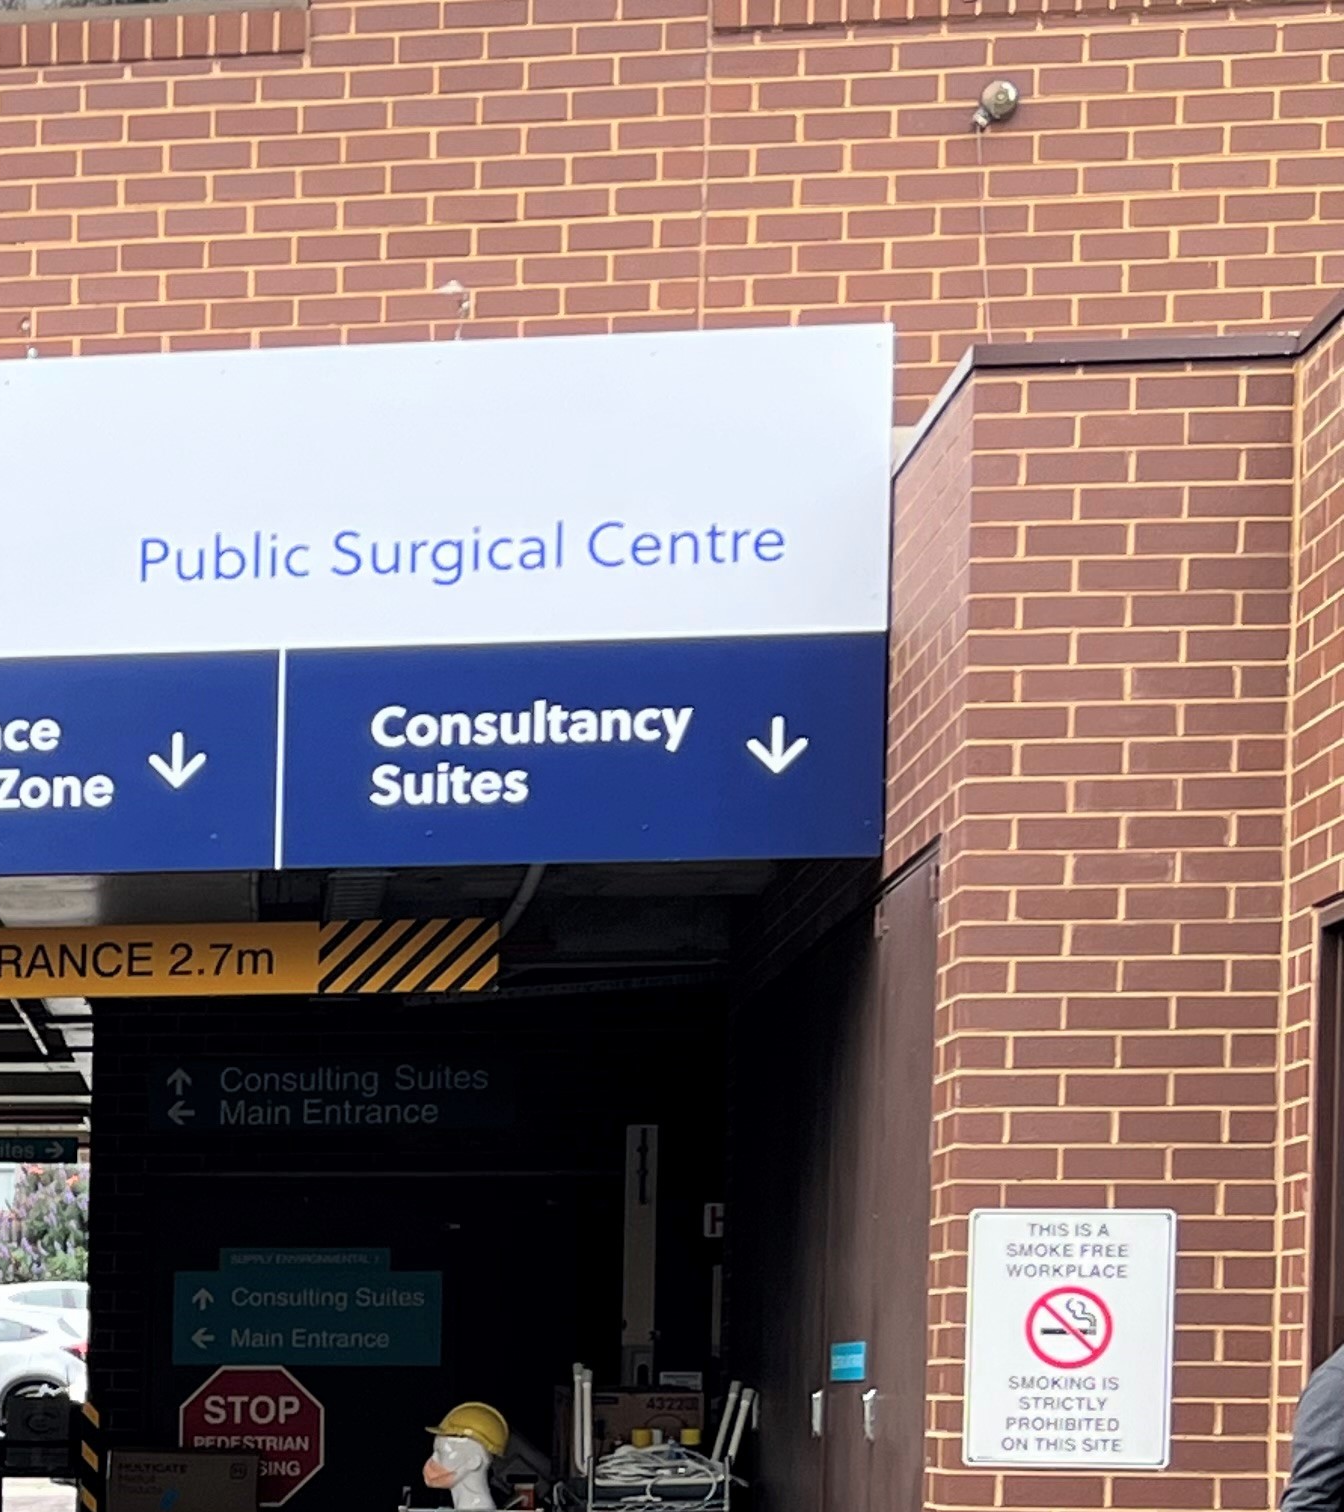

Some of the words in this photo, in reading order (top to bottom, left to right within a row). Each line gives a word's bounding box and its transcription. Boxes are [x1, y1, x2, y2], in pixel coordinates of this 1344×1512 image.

[138, 529, 310, 584] Public
[330, 520, 566, 586] Surgical
[585, 519, 788, 569] Centre
[369, 699, 694, 758] Consultancy
[368, 760, 531, 808] Suites
[167, 942, 275, 979] 2.7m
[219, 1066, 380, 1098] Consulting
[395, 1063, 490, 1091] Suites
[219, 1099, 292, 1126] Main
[302, 1097, 439, 1126] Entrance
[1028, 1222, 1070, 1238] THIS
[1074, 1222, 1092, 1238] IS
[1095, 1222, 1111, 1238] A
[1005, 1243, 1074, 1258] SMOKE
[1080, 1243, 1130, 1258] FREE
[1005, 1263, 1129, 1279] WORKPLACE
[230, 1287, 349, 1312] Consulting
[355, 1287, 426, 1308] Suites
[230, 1328, 284, 1349] Main
[291, 1328, 390, 1349] Entrance
[1008, 1375, 1097, 1392] SMOKING
[1101, 1375, 1120, 1391] IS
[203, 1394, 301, 1426] STOP
[1018, 1396, 1109, 1412] STRICTLY
[1005, 1416, 1120, 1432] PROHIBITED
[192, 1435, 310, 1452] PEDESTRIAN
[1001, 1436, 1029, 1452] ON
[1036, 1436, 1076, 1452] THIS
[1083, 1436, 1123, 1452] SITE
[258, 1459, 302, 1478] SING
